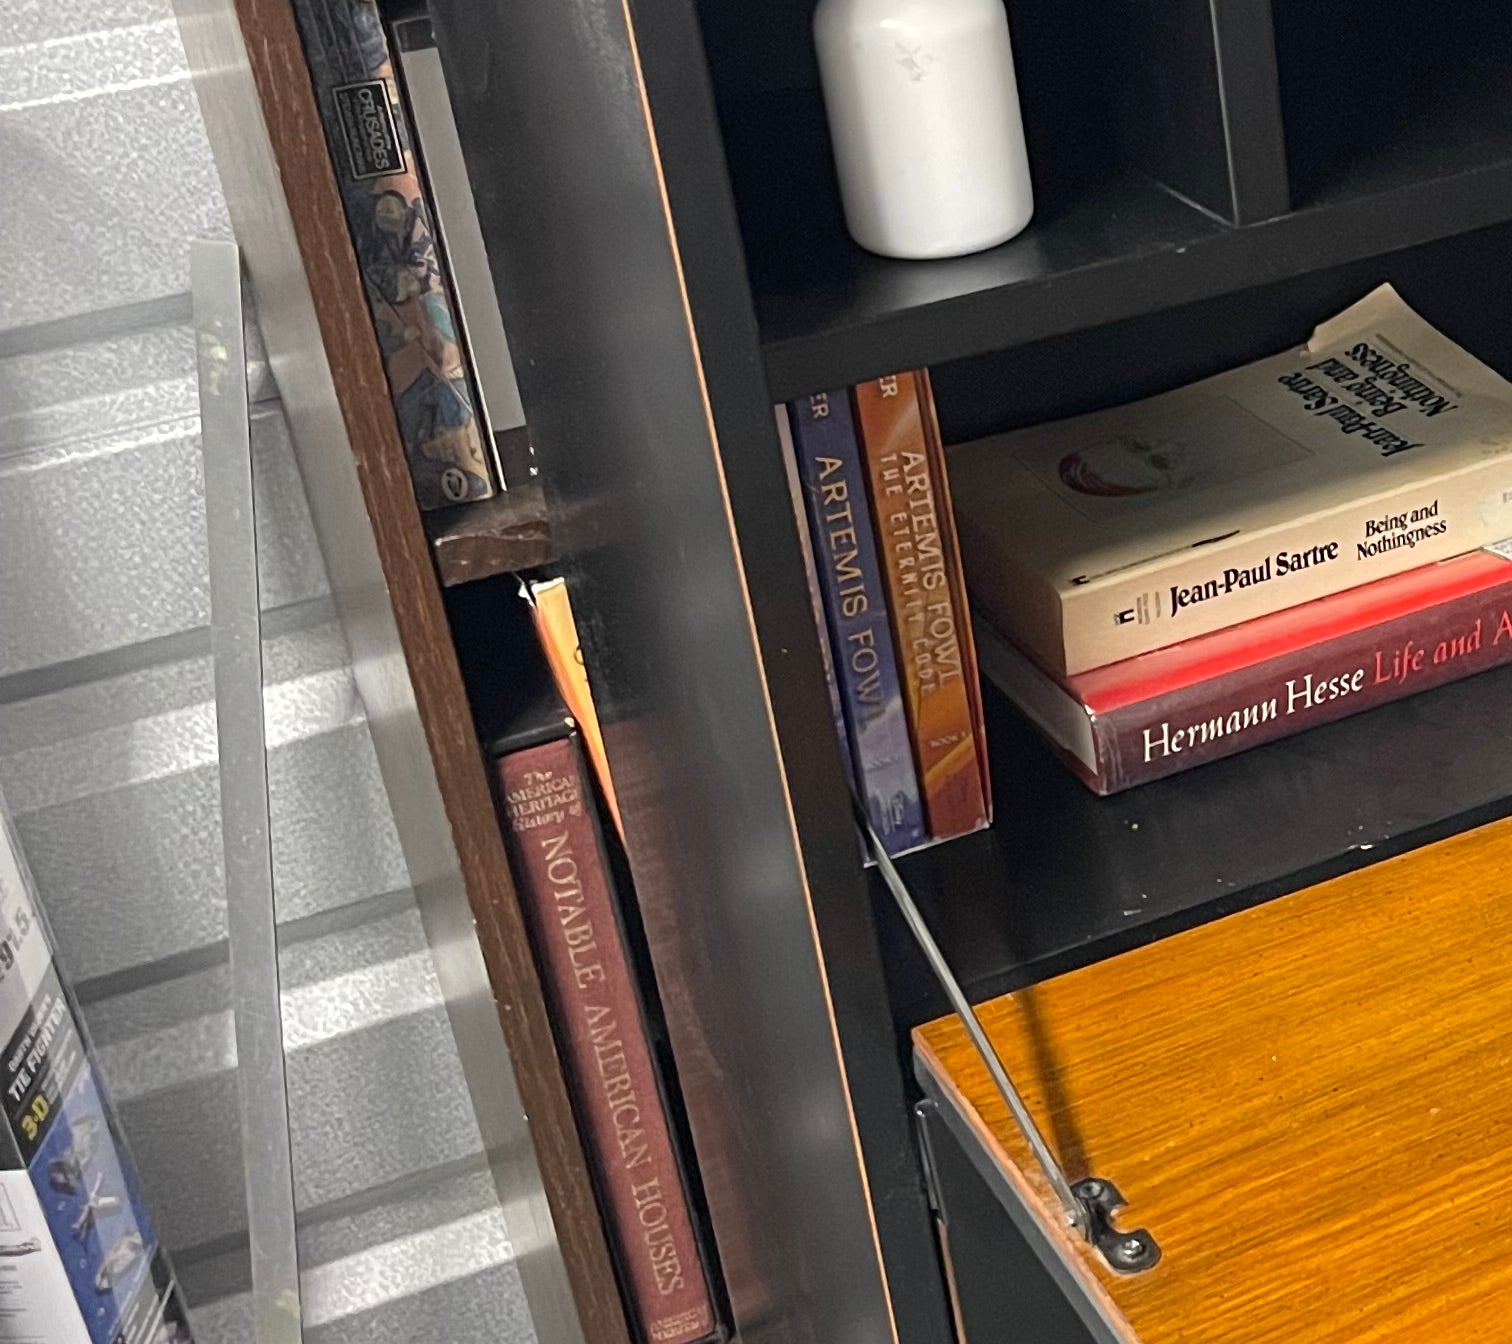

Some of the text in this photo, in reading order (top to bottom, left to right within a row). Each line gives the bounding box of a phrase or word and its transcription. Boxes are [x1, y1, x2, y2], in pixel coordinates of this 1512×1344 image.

[358, 88, 391, 169] CRUSADES
[1278, 372, 1425, 457] Jean-Paul Sartre
[1305, 358, 1408, 417] Being and
[1344, 342, 1459, 417] Nothingness
[814, 455, 868, 618] ARTEMIS
[1356, 520, 1447, 561] Nothingness
[1364, 499, 1439, 539] Being and
[890, 510, 925, 623] ETERNITY
[912, 638, 940, 696] CODE
[901, 450, 961, 680] ARTEMIS FOWL
[1170, 541, 1339, 618] Jean-Paul Sartre
[1143, 698, 1278, 762] Hermann
[1285, 667, 1364, 714] Hesse
[1374, 640, 1424, 686] Life
[1433, 617, 1482, 665] and
[26, 996, 67, 1074] FIGHTER
[540, 829, 685, 1297] NOTABLE AMERICAN HOUSES
